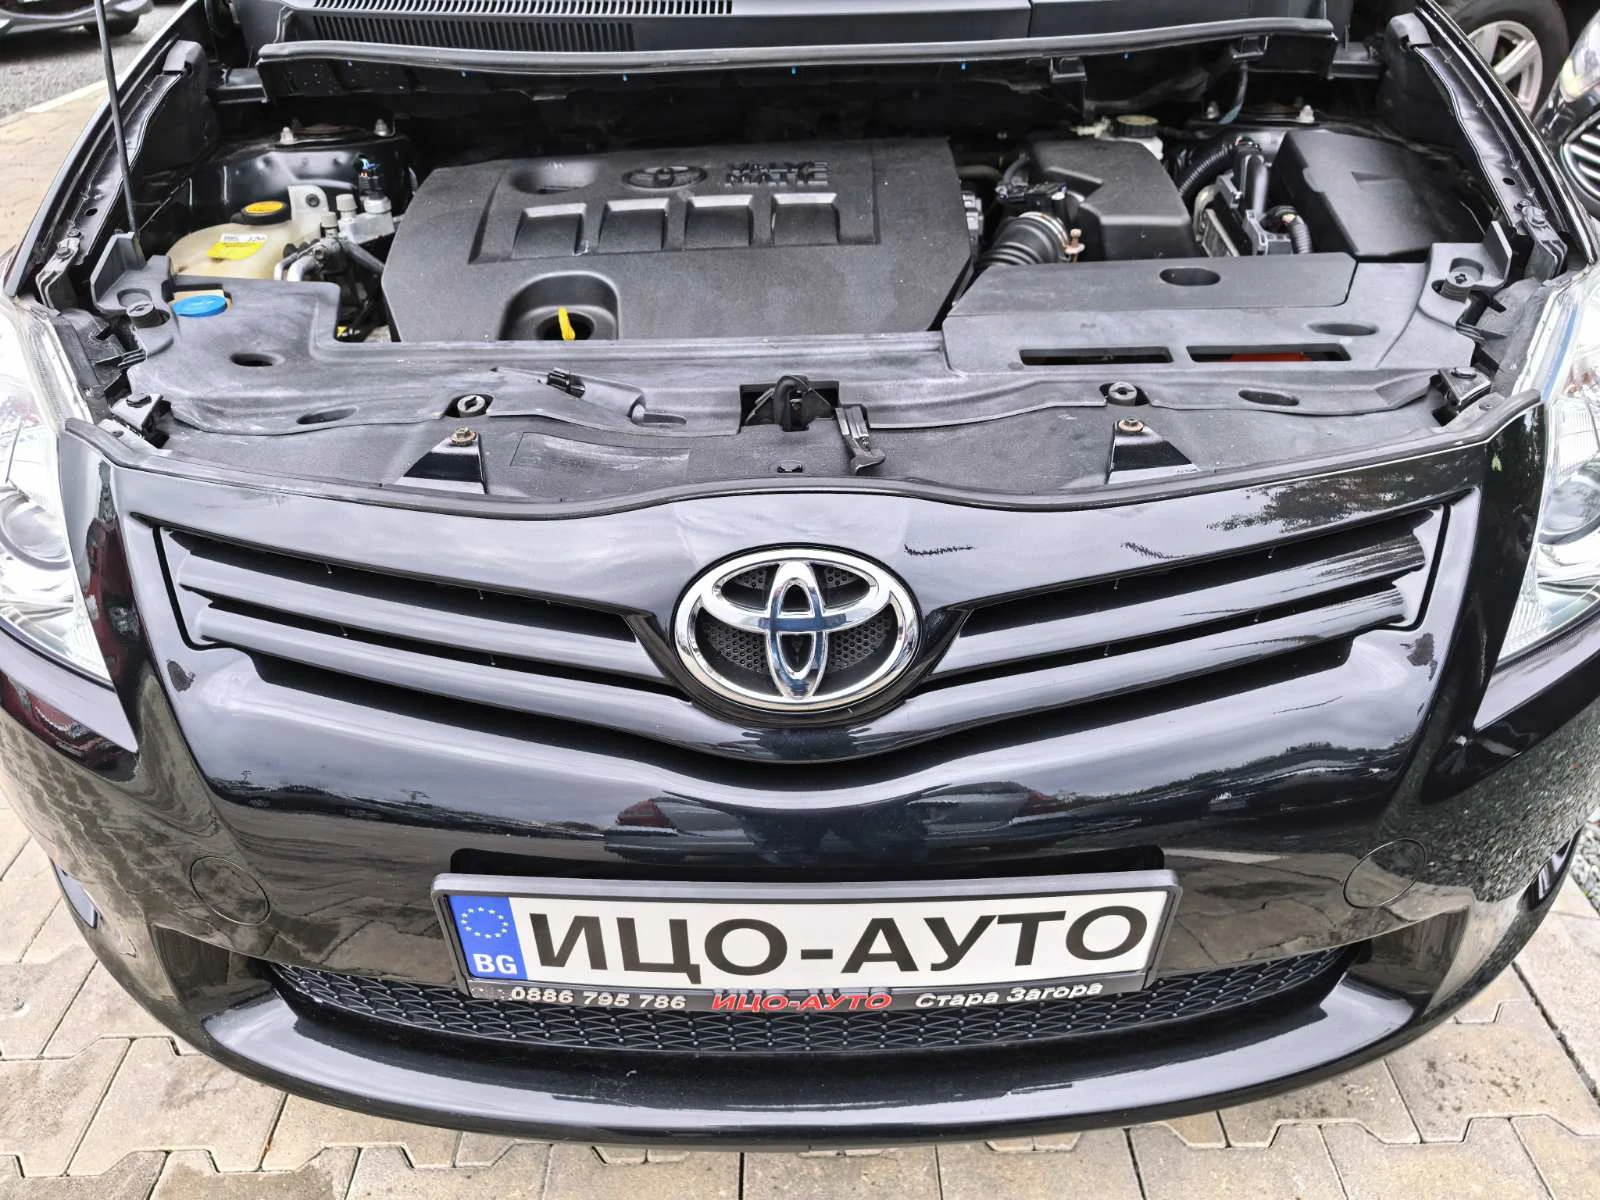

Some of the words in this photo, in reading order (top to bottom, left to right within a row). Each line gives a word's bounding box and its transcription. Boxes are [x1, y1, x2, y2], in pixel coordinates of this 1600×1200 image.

[529, 905, 1148, 985] ИЦО-АУТО
[472, 953, 518, 975] BG
[511, 986, 574, 1004] 0886
[583, 991, 630, 1007] 795
[639, 994, 687, 1009] 786
[711, 993, 893, 1013] ИЦО-АУТО
[915, 991, 1000, 1008] Стара
[1006, 982, 1104, 1003] Загора
